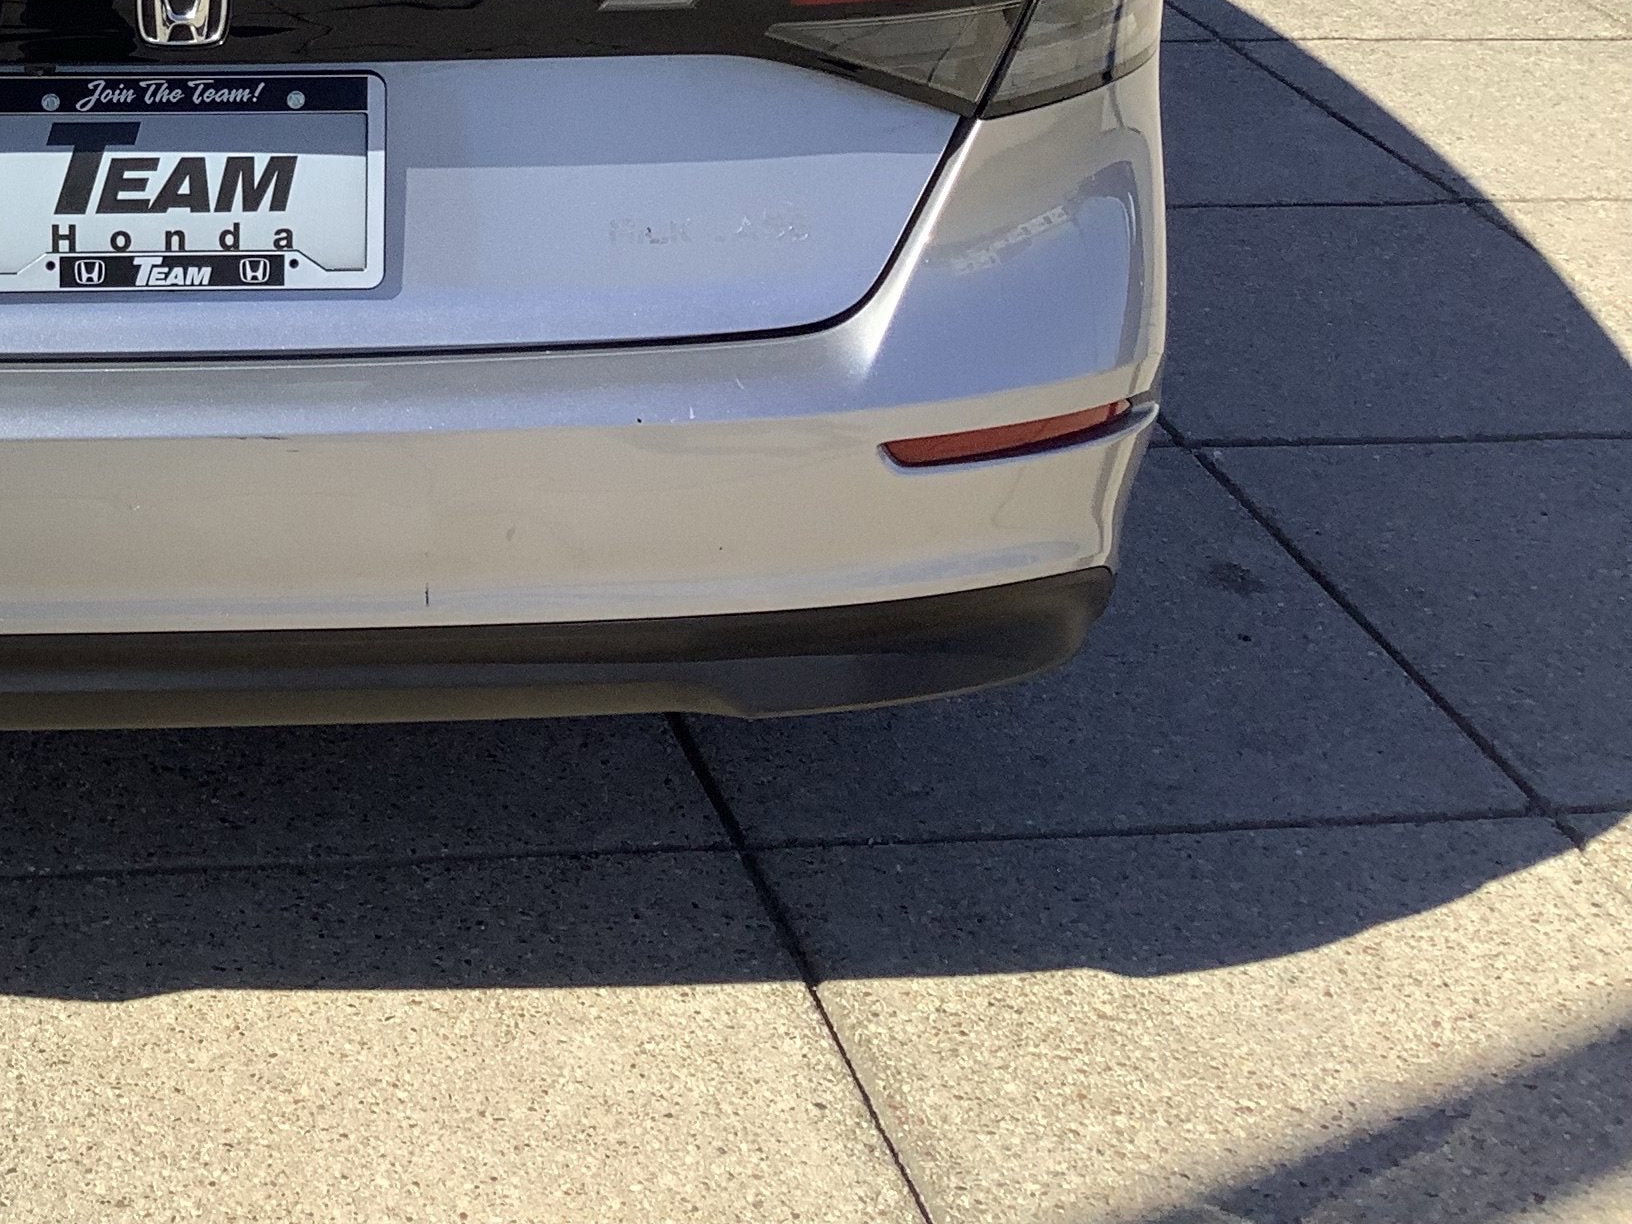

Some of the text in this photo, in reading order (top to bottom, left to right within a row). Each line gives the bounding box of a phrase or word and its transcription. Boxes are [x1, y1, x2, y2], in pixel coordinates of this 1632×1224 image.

[76, 79, 265, 111] Join The Team!
[45, 122, 298, 215] TEAM
[51, 222, 294, 253] Honda
[132, 256, 212, 286] TEAM
